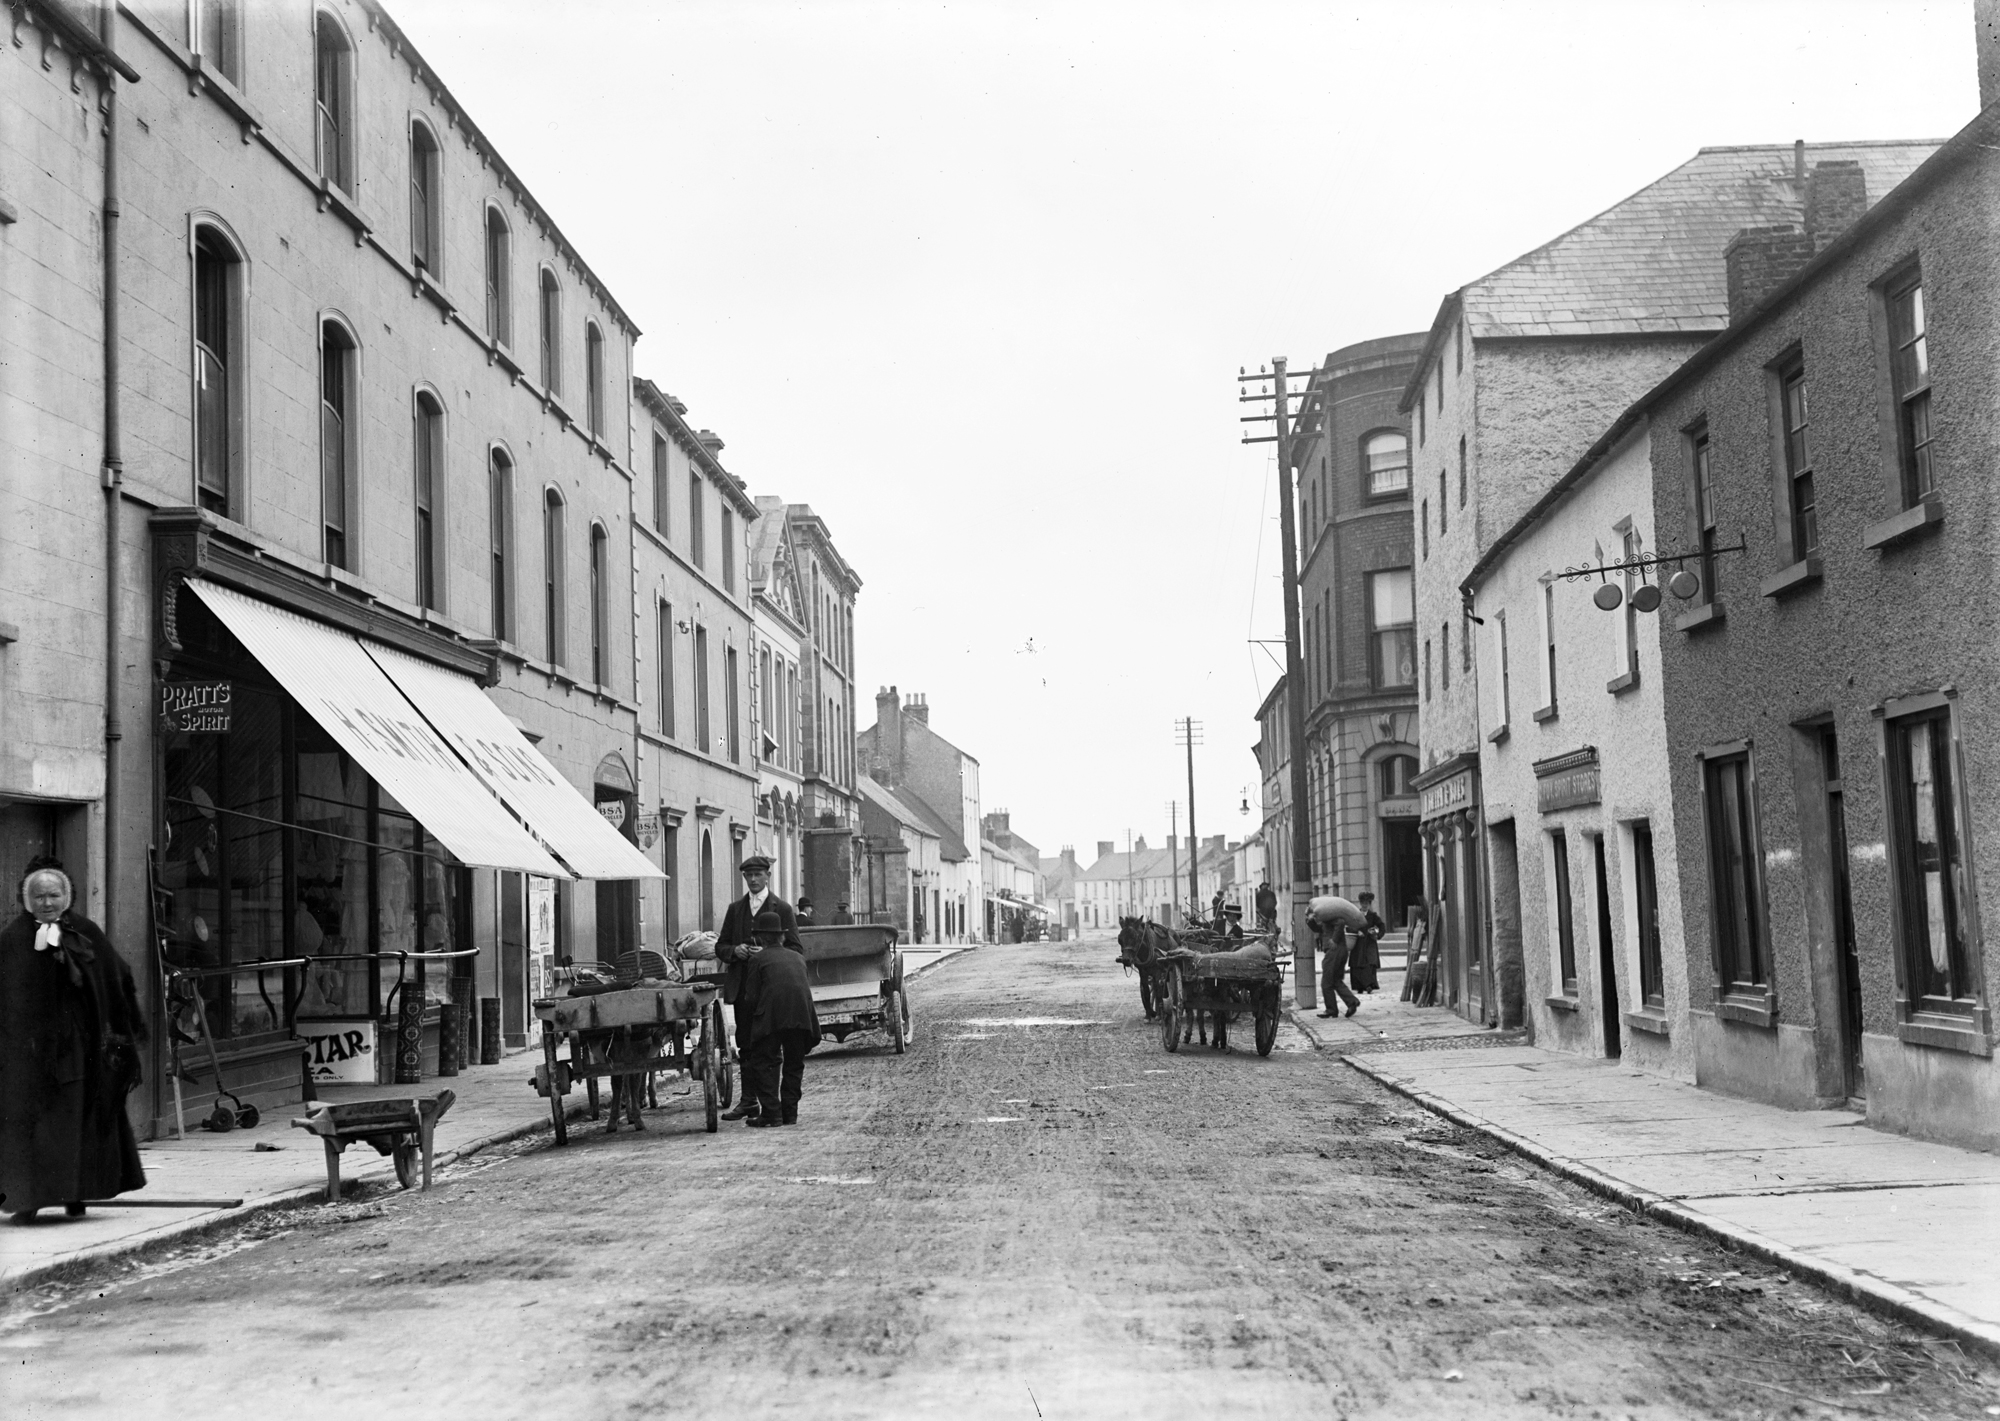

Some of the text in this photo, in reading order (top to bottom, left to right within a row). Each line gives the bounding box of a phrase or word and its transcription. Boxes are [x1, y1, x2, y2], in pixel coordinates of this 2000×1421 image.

[160, 683, 230, 716] PRATT'S
[180, 713, 230, 731] SPIRIT
[354, 707, 461, 773] SMITH
[454, 733, 494, 777] &
[476, 738, 556, 787] SONS
[1573, 771, 1596, 794] STORES
